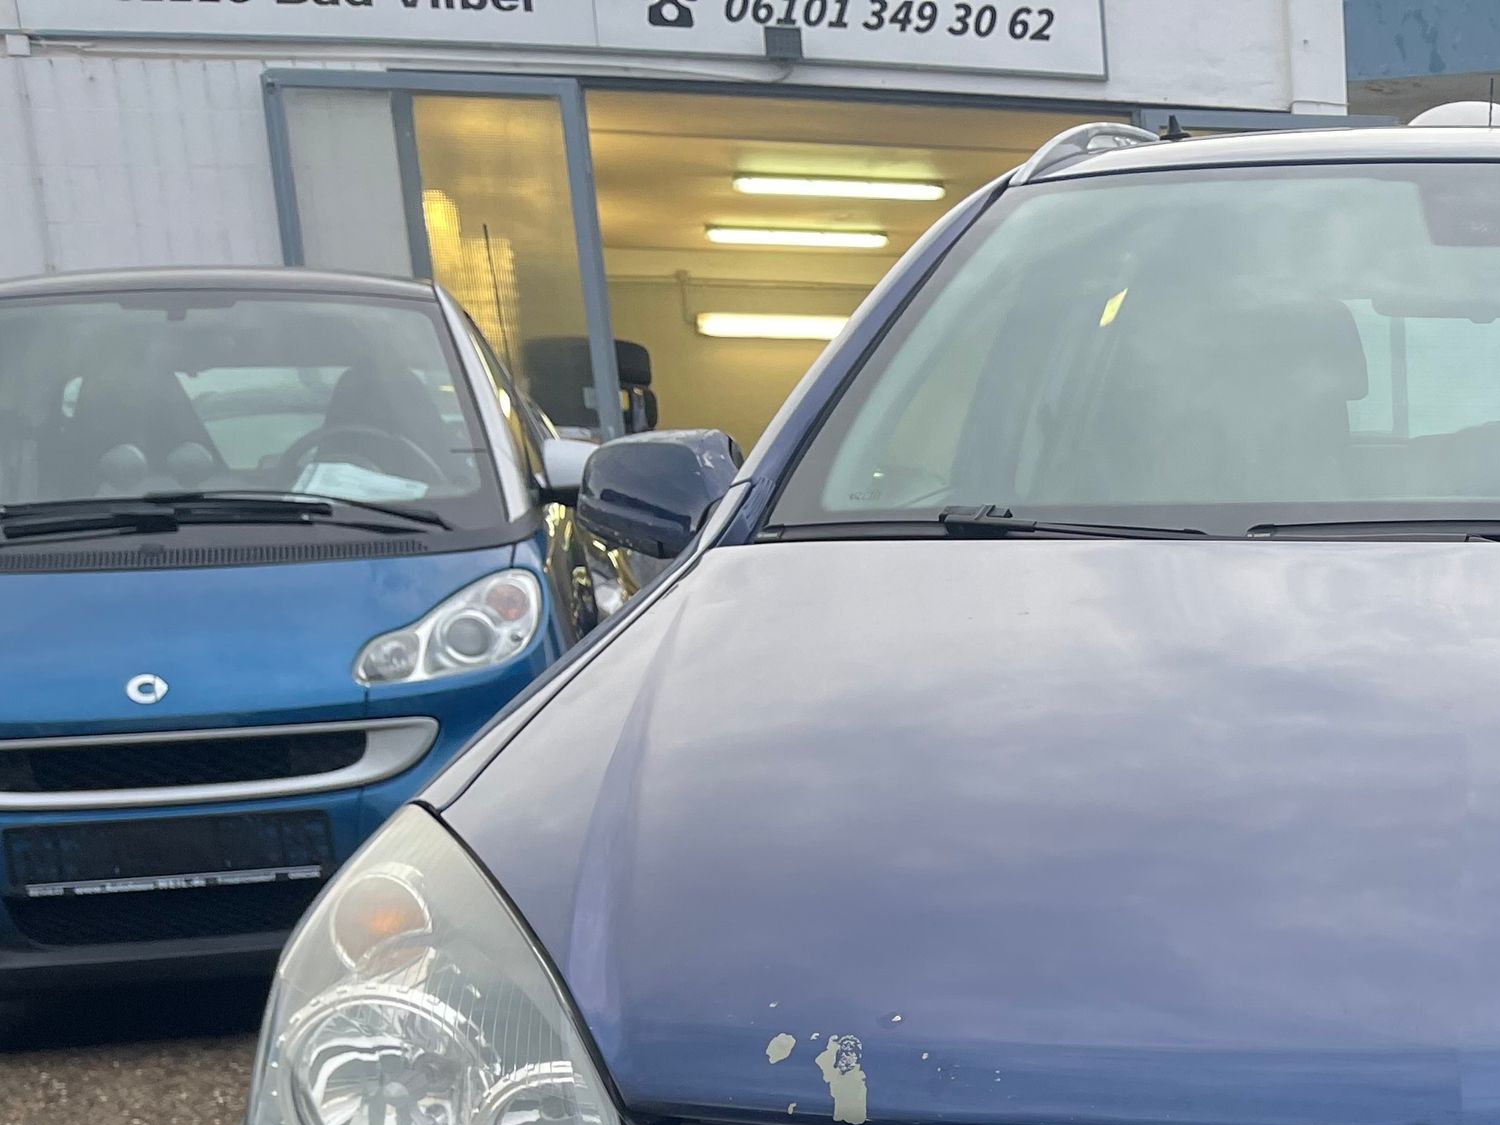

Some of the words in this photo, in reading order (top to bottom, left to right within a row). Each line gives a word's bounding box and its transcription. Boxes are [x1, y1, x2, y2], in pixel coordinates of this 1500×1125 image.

[725, 0, 849, 29] 06101
[862, 1, 938, 33] 349
[948, 4, 997, 38] 30
[1008, 7, 1055, 41] 62
